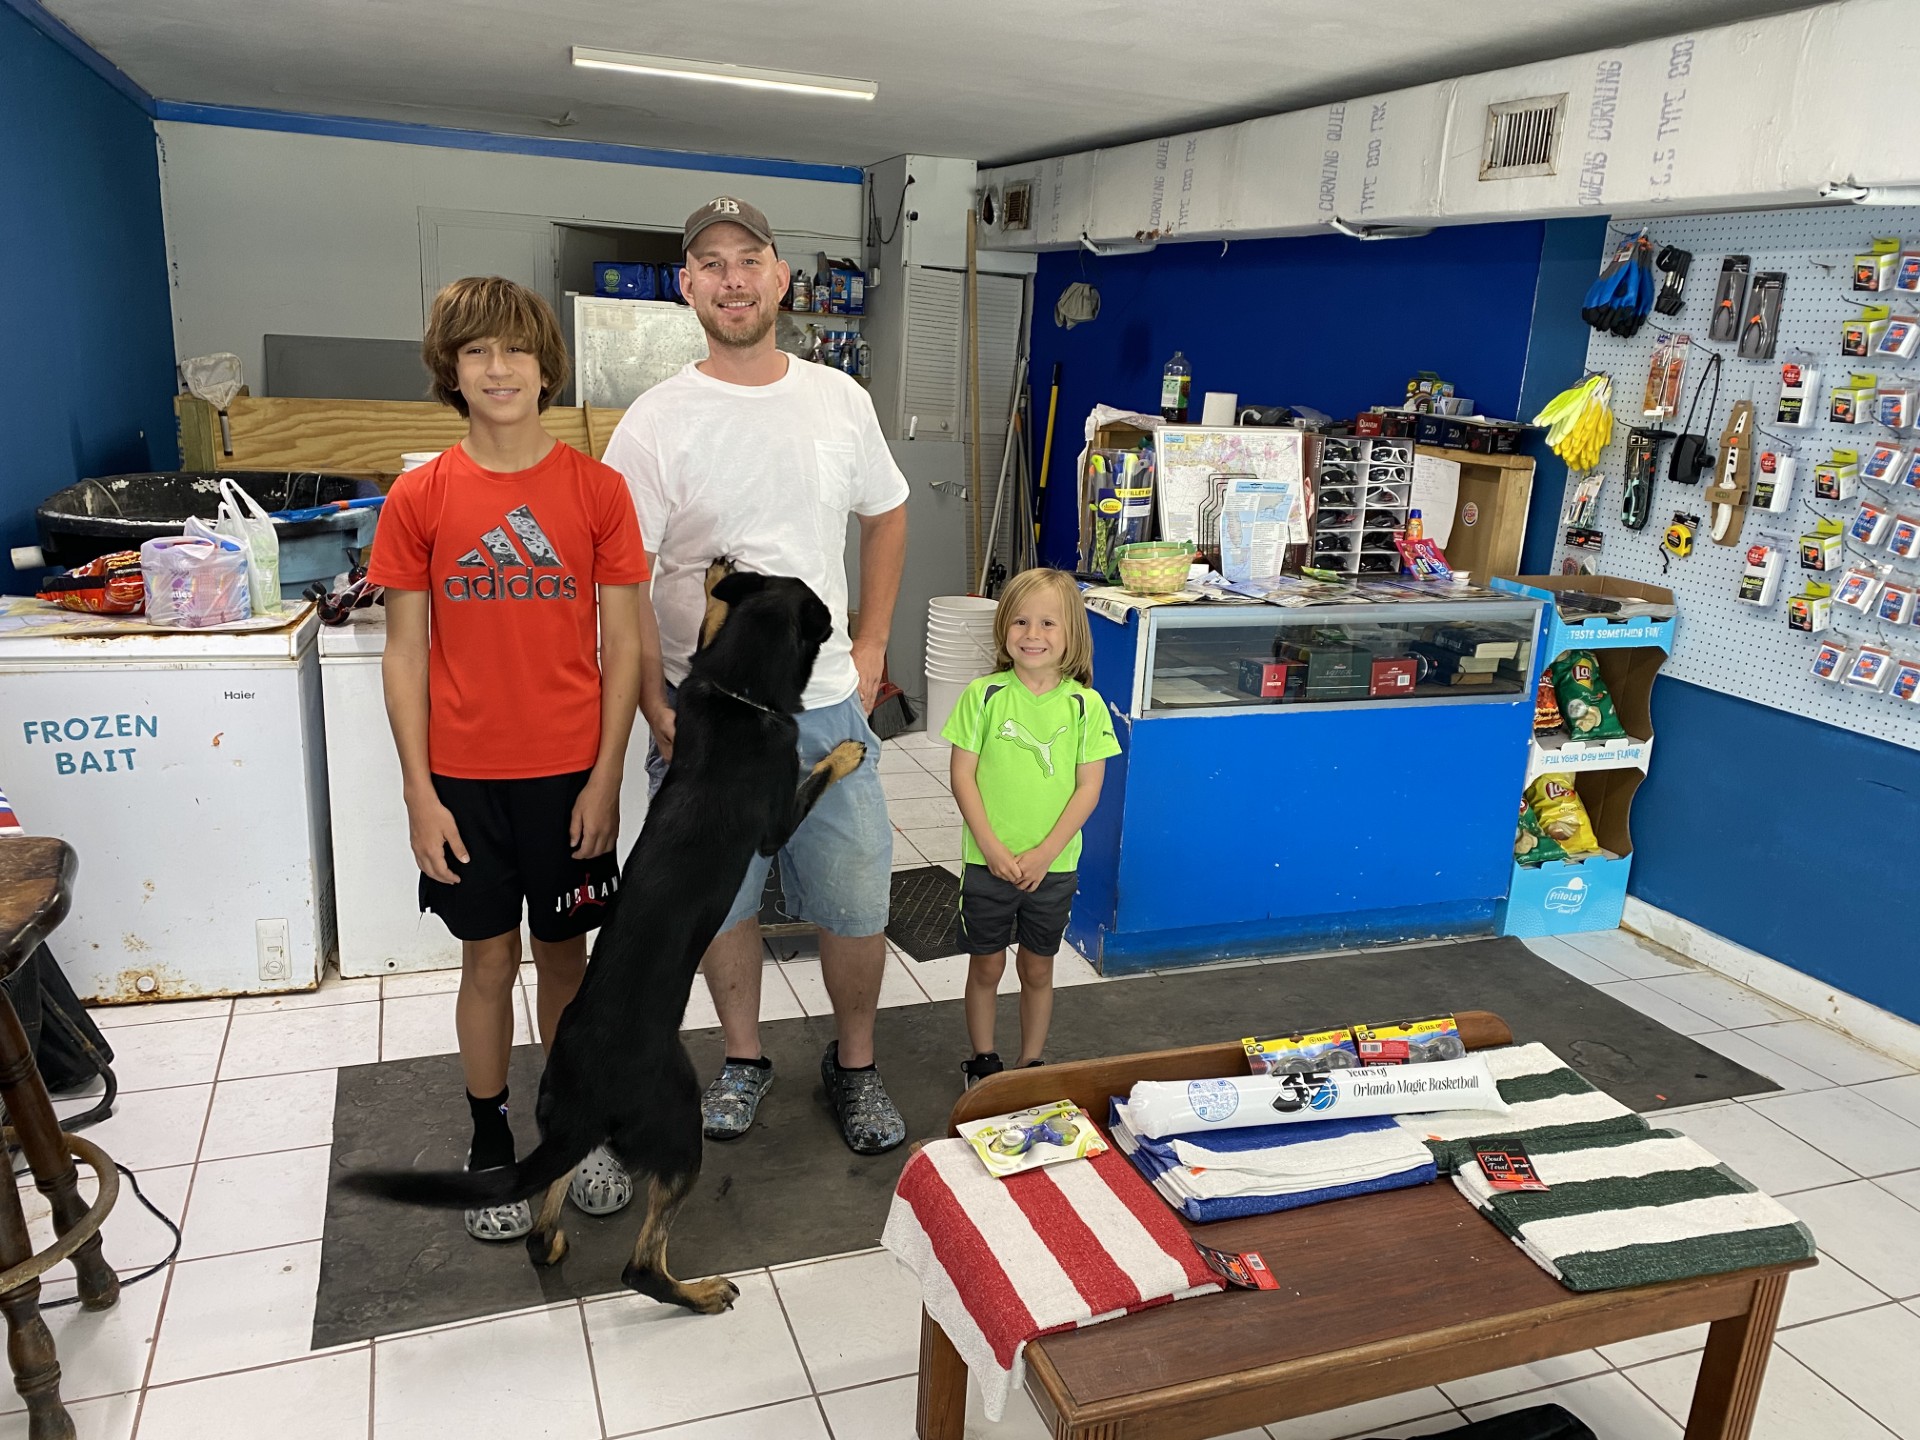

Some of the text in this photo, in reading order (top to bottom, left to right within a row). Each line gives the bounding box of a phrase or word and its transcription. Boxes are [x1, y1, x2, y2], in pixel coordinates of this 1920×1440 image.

[1578, 60, 1622, 206] OWENS CORNING
[1319, 150, 1340, 212] CORNING
[1150, 175, 1165, 227] CORNING
[444, 566, 577, 601] adidas
[224, 691, 255, 700] Haier
[23, 714, 157, 744] FROZEN
[55, 748, 136, 775] BAIT
[555, 876, 619, 912] JORDAN
[1346, 1067, 1388, 1078] Years of
[1353, 1075, 1480, 1097] Orlando Magic Basketball
[1482, 1154, 1505, 1163] Beach
[1487, 1162, 1509, 1171] Towel
